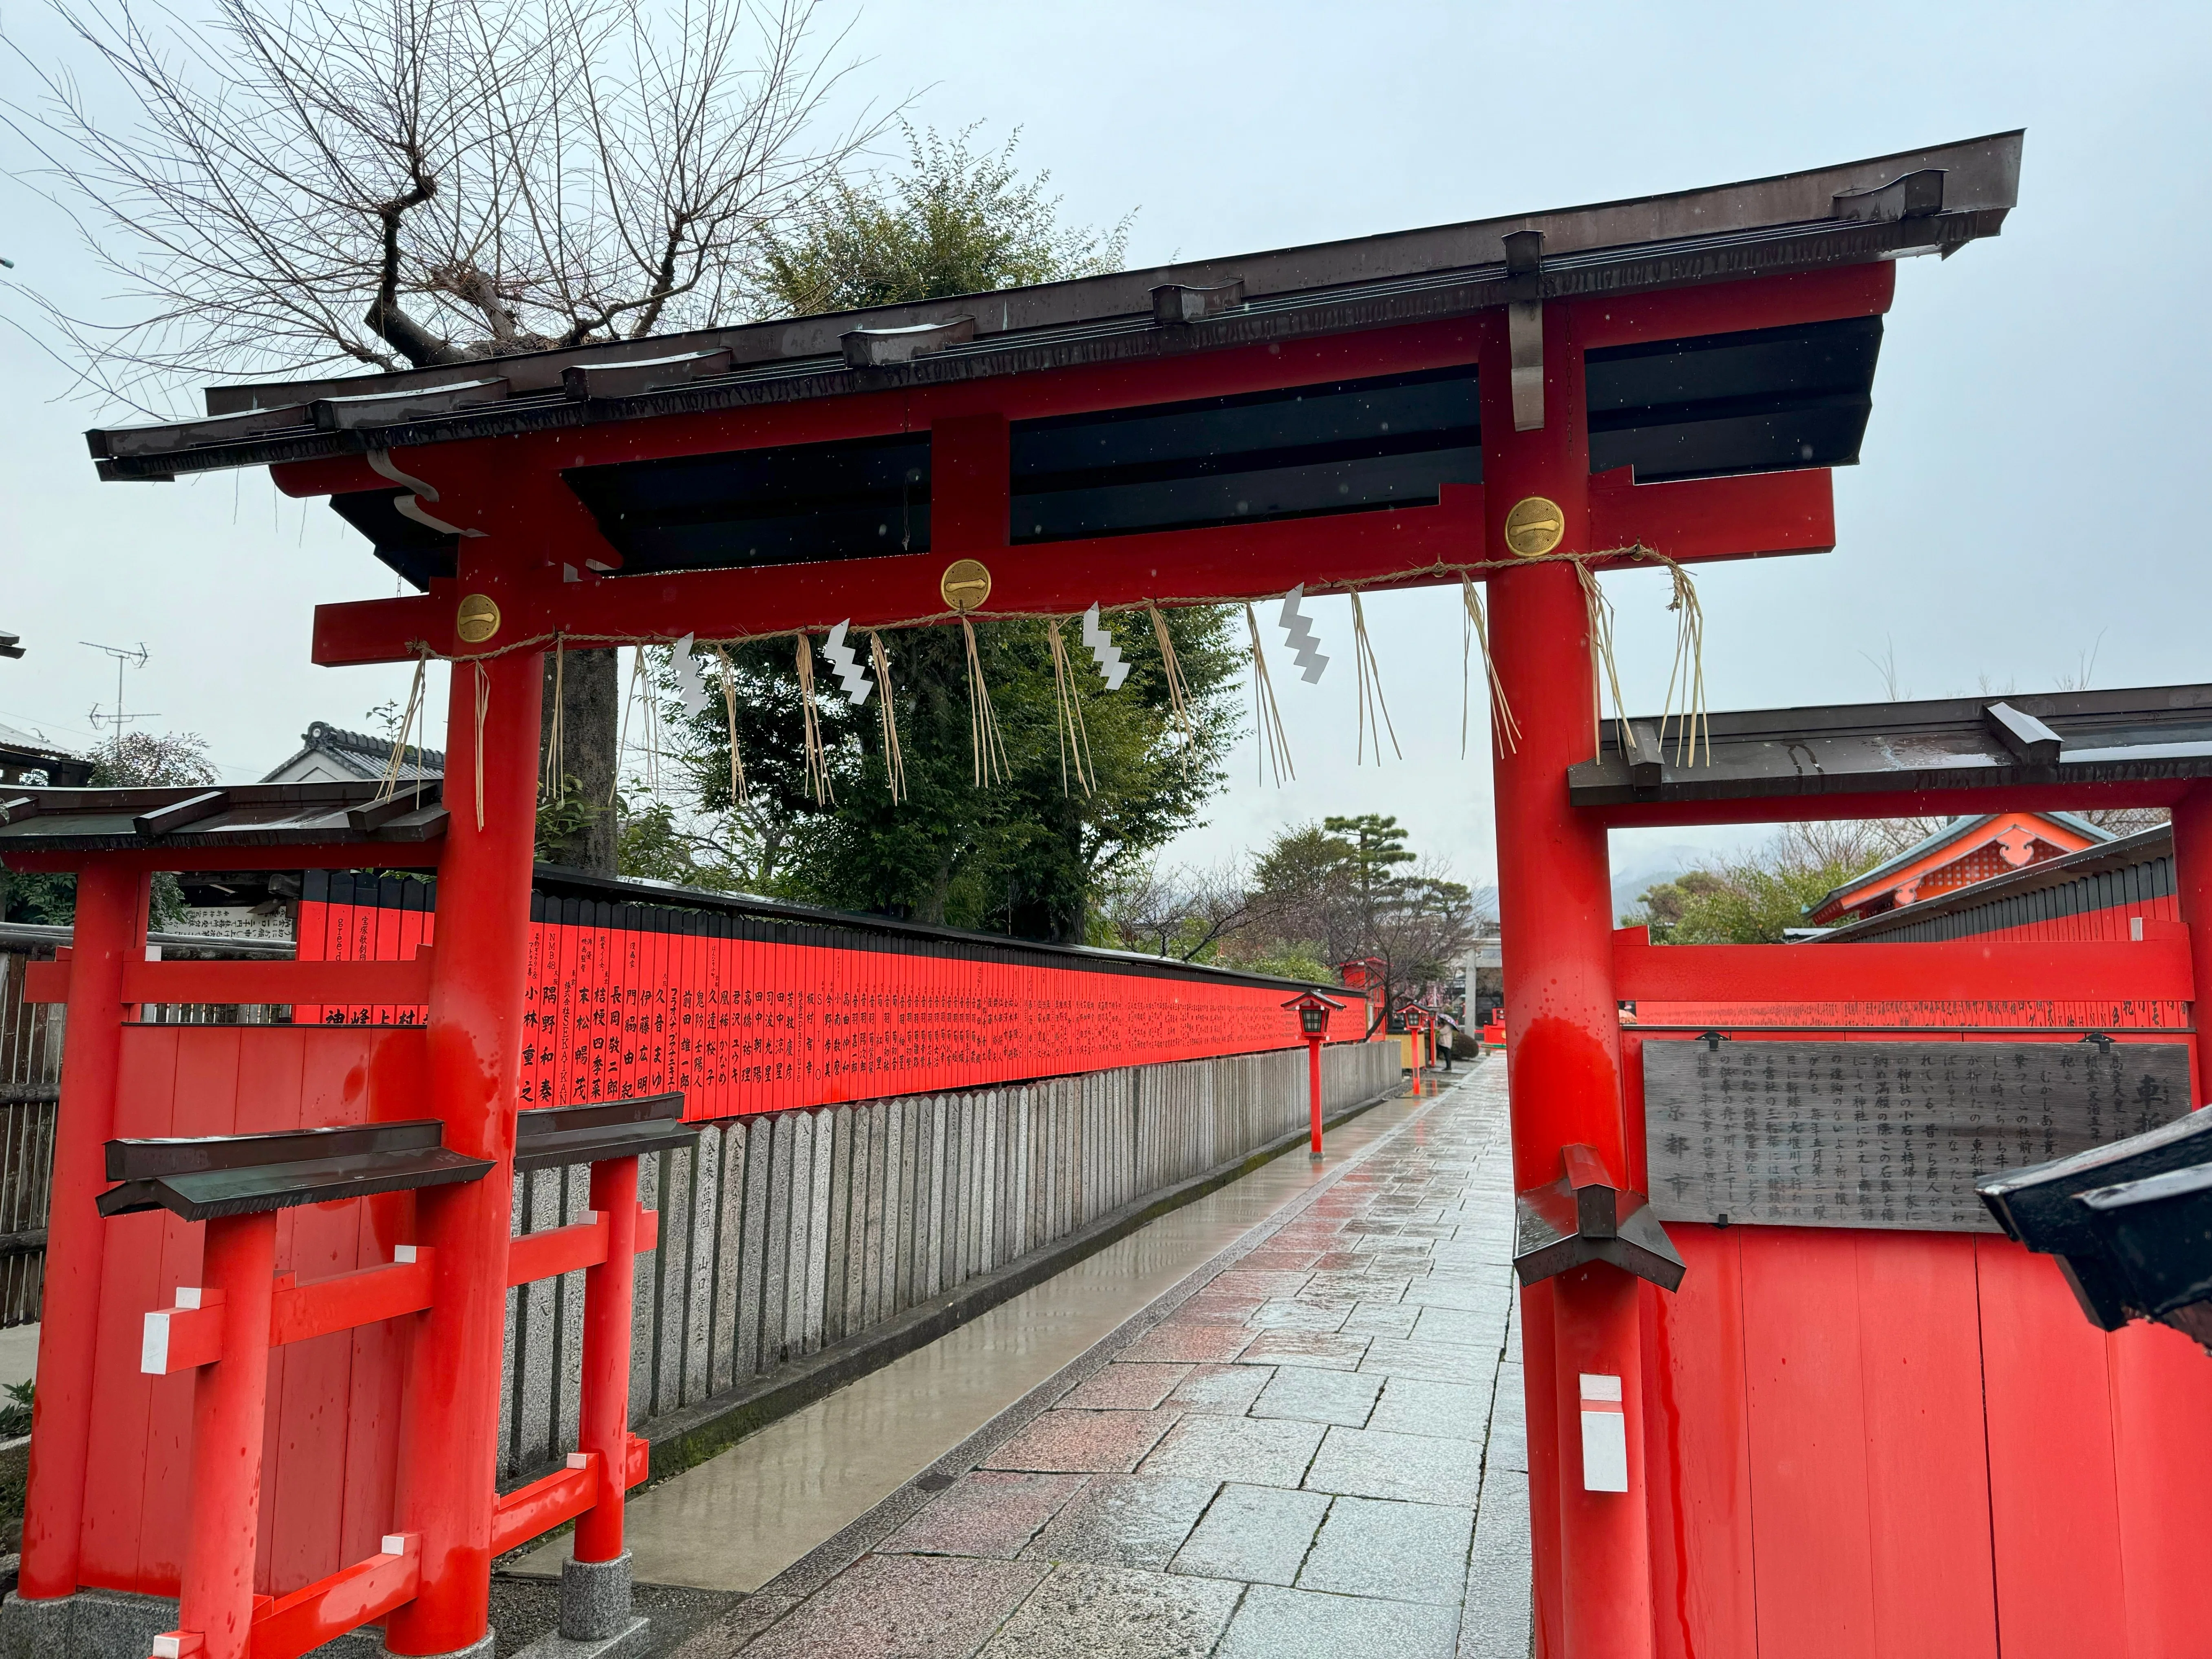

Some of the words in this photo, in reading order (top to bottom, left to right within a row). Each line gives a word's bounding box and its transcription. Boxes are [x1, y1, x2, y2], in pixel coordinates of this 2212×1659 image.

[547, 933, 556, 970] NMB48
[519, 985, 538, 1103] 小林重之
[607, 985, 621, 1099] 長岡敬二郎
[637, 989, 652, 1095] 伊藤広明
[652, 988, 665, 1090] 久音まゆ
[706, 988, 717, 1086] 久遠桜子
[730, 990, 740, 1085] 君沢ユウキ
[753, 991, 763, 1084] 田中朝陽
[775, 991, 784, 1080] 田中涼星
[785, 990, 795, 1082] 荒牧慶彦
[1658, 1098, 1694, 1202] 京都市
[2039, 1070, 2057, 1161] むかし、ある貴
